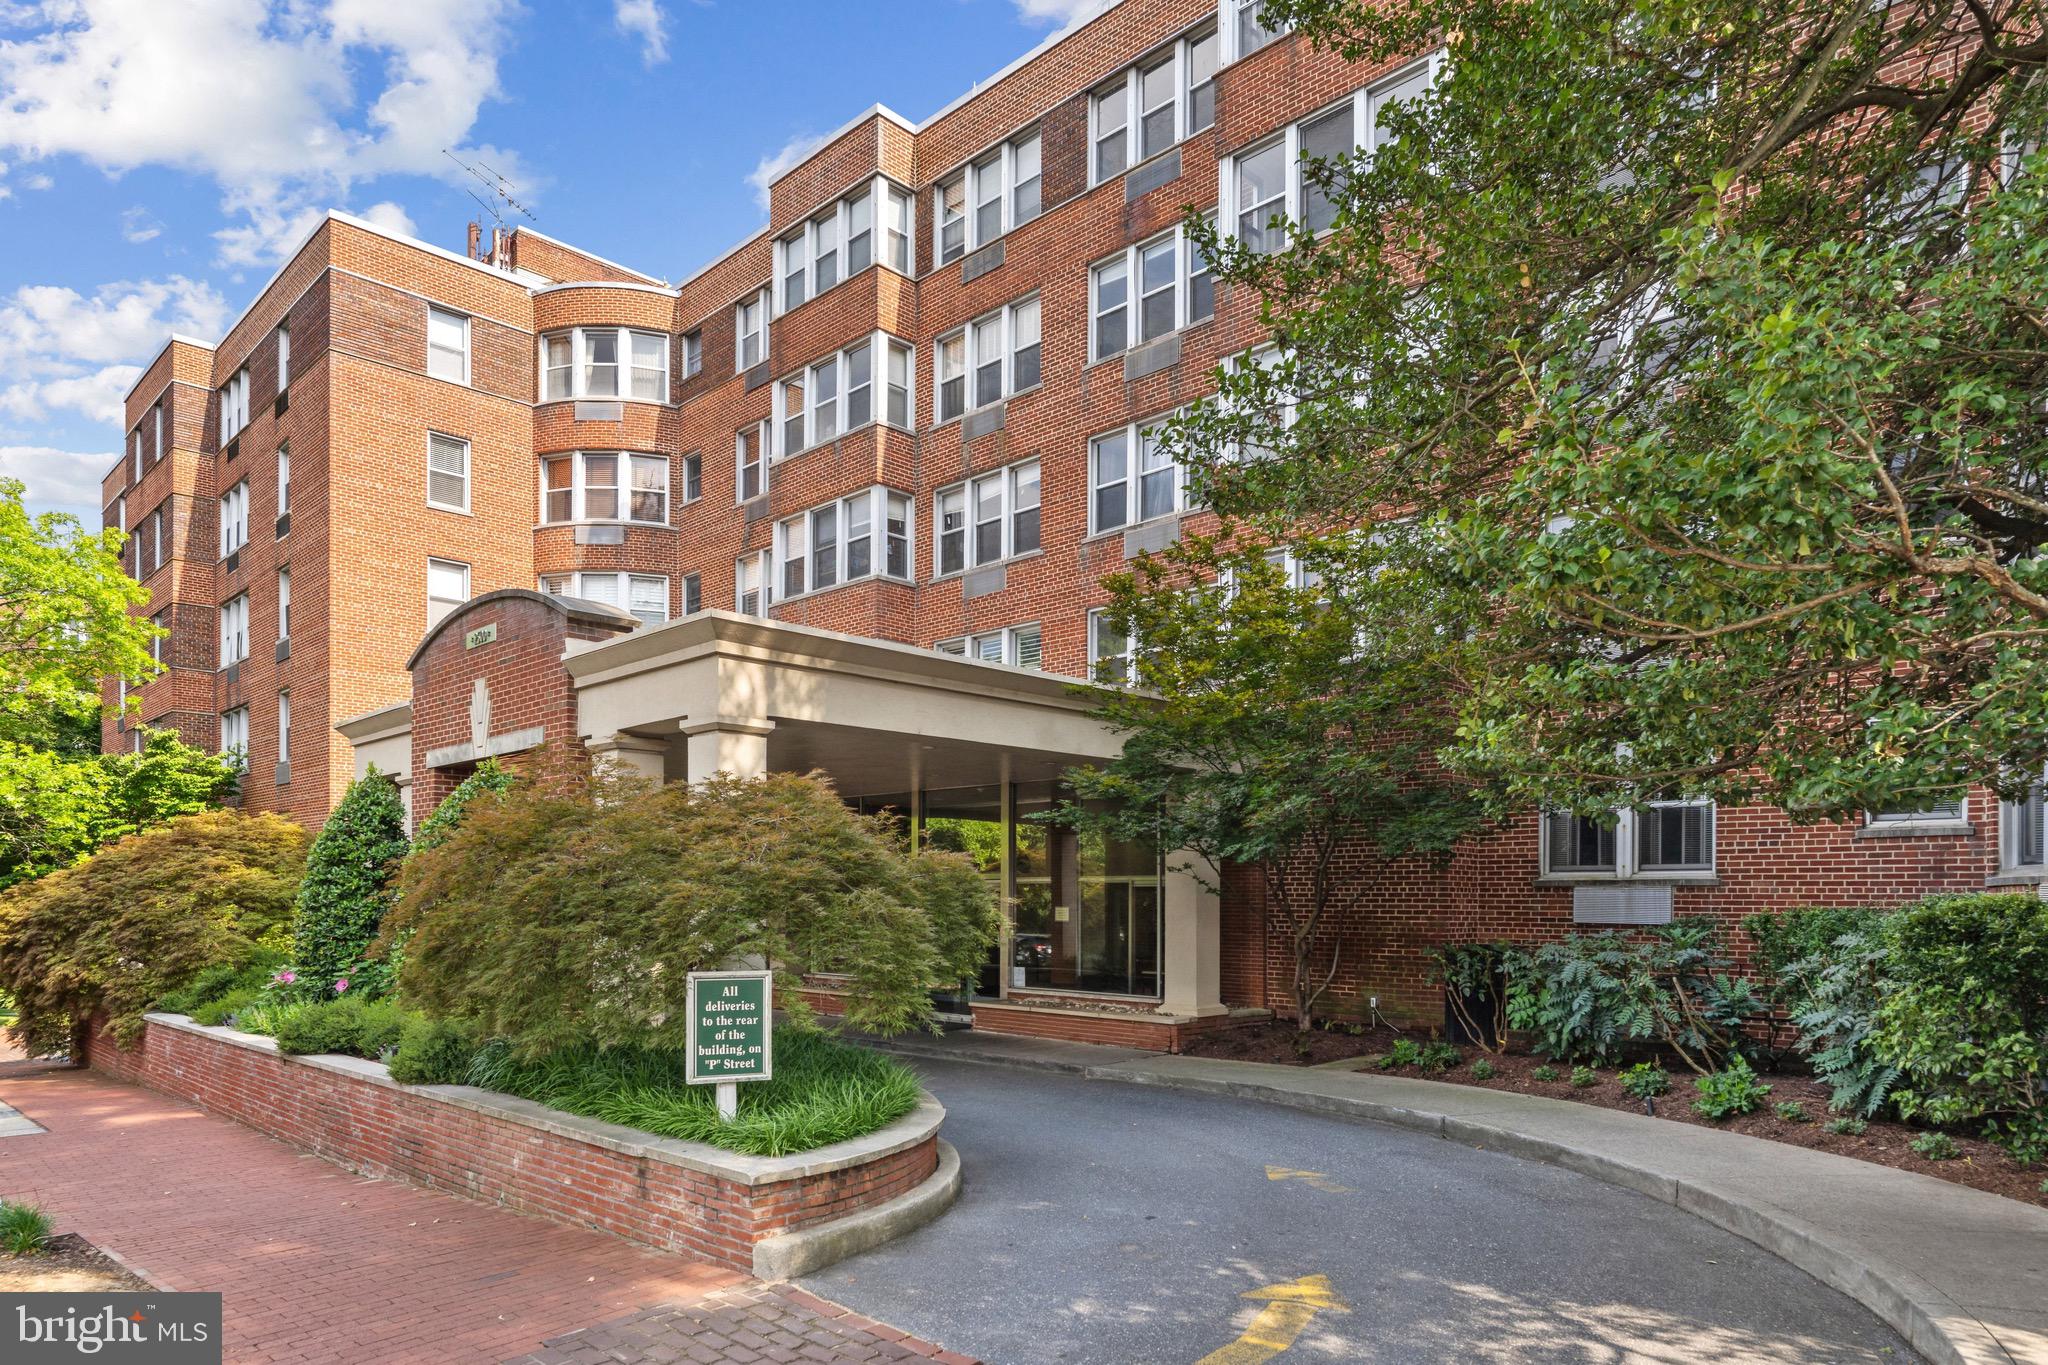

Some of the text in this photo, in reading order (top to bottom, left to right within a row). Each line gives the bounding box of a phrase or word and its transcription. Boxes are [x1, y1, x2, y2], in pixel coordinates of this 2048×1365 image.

[722, 985, 739, 997] All
[705, 1000, 756, 1012] deliveries
[702, 1015, 759, 1027] to the rear
[715, 1029, 746, 1041] of the
[698, 1044, 762, 1057] building, on
[723, 1058, 756, 1070] Street
